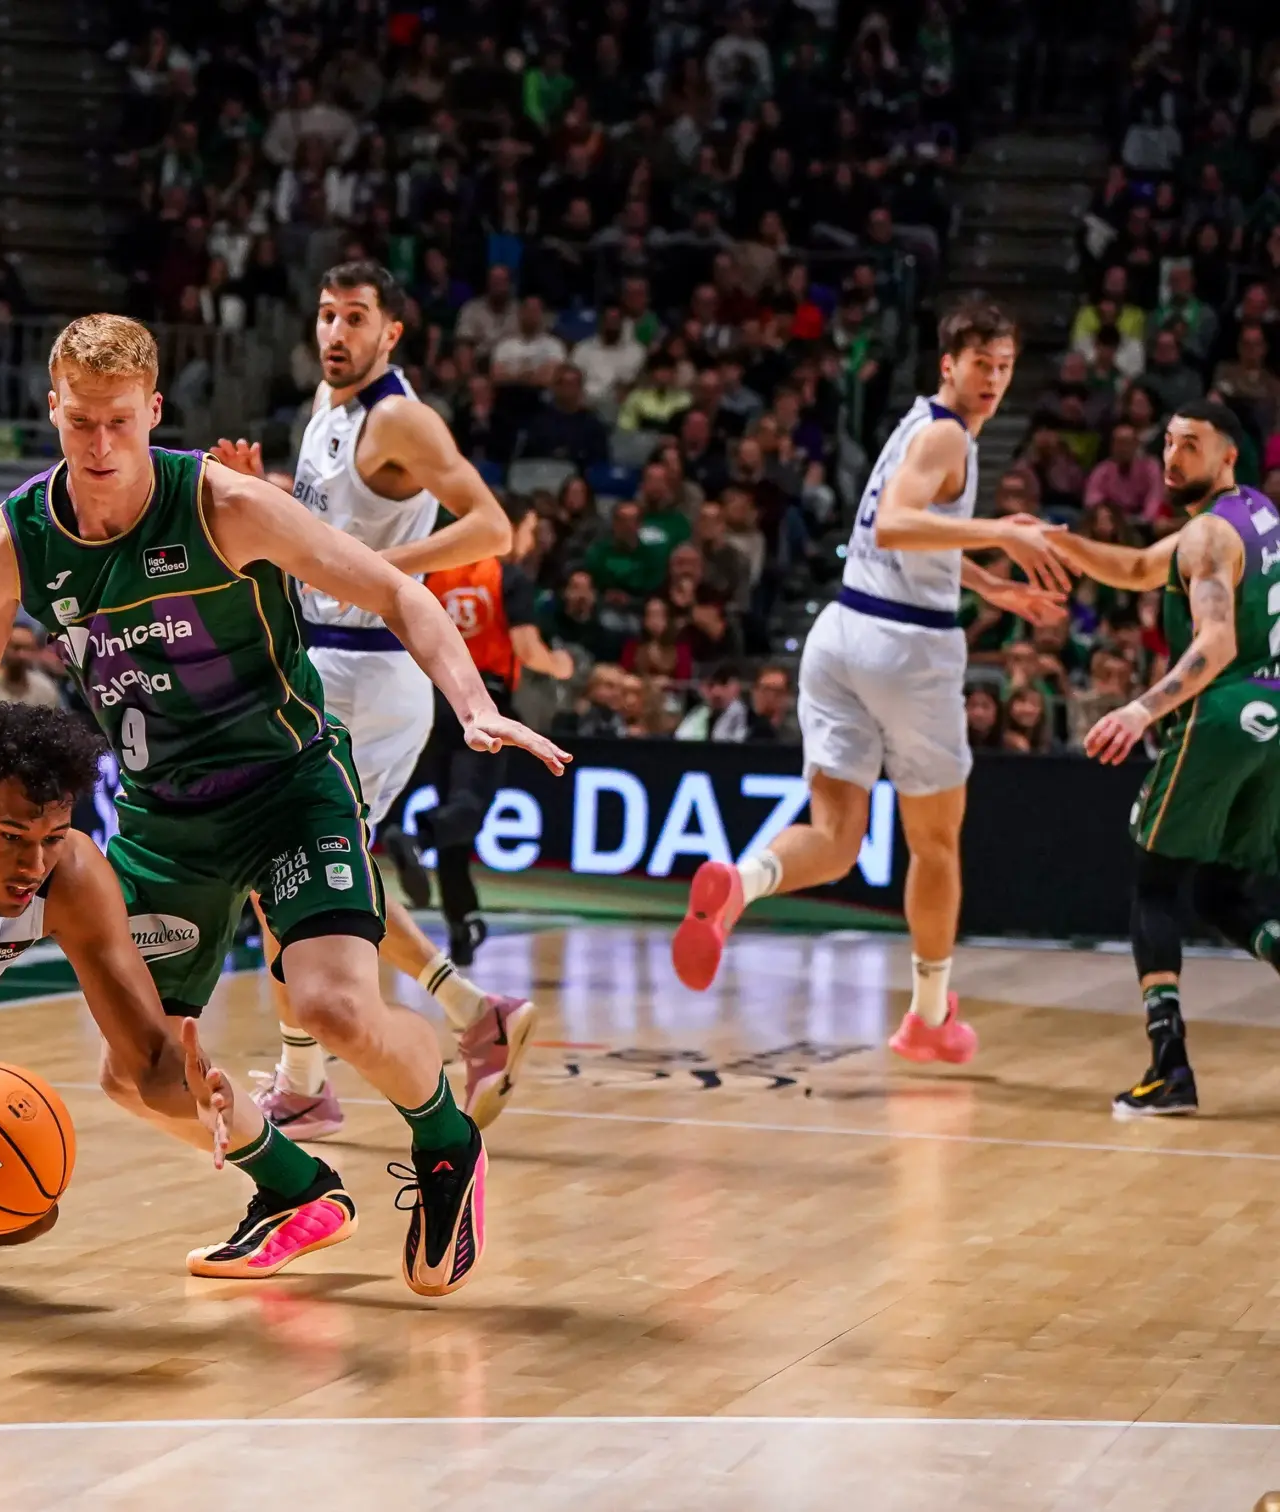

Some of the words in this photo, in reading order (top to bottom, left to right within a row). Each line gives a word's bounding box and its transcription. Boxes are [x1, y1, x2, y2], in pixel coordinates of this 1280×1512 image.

[148, 557, 165, 567] liga
[150, 562, 185, 573] endesa
[89, 615, 193, 658] Unicaja
[93, 669, 172, 707] álaga
[122, 707, 149, 771] 9
[321, 841, 343, 849] acb
